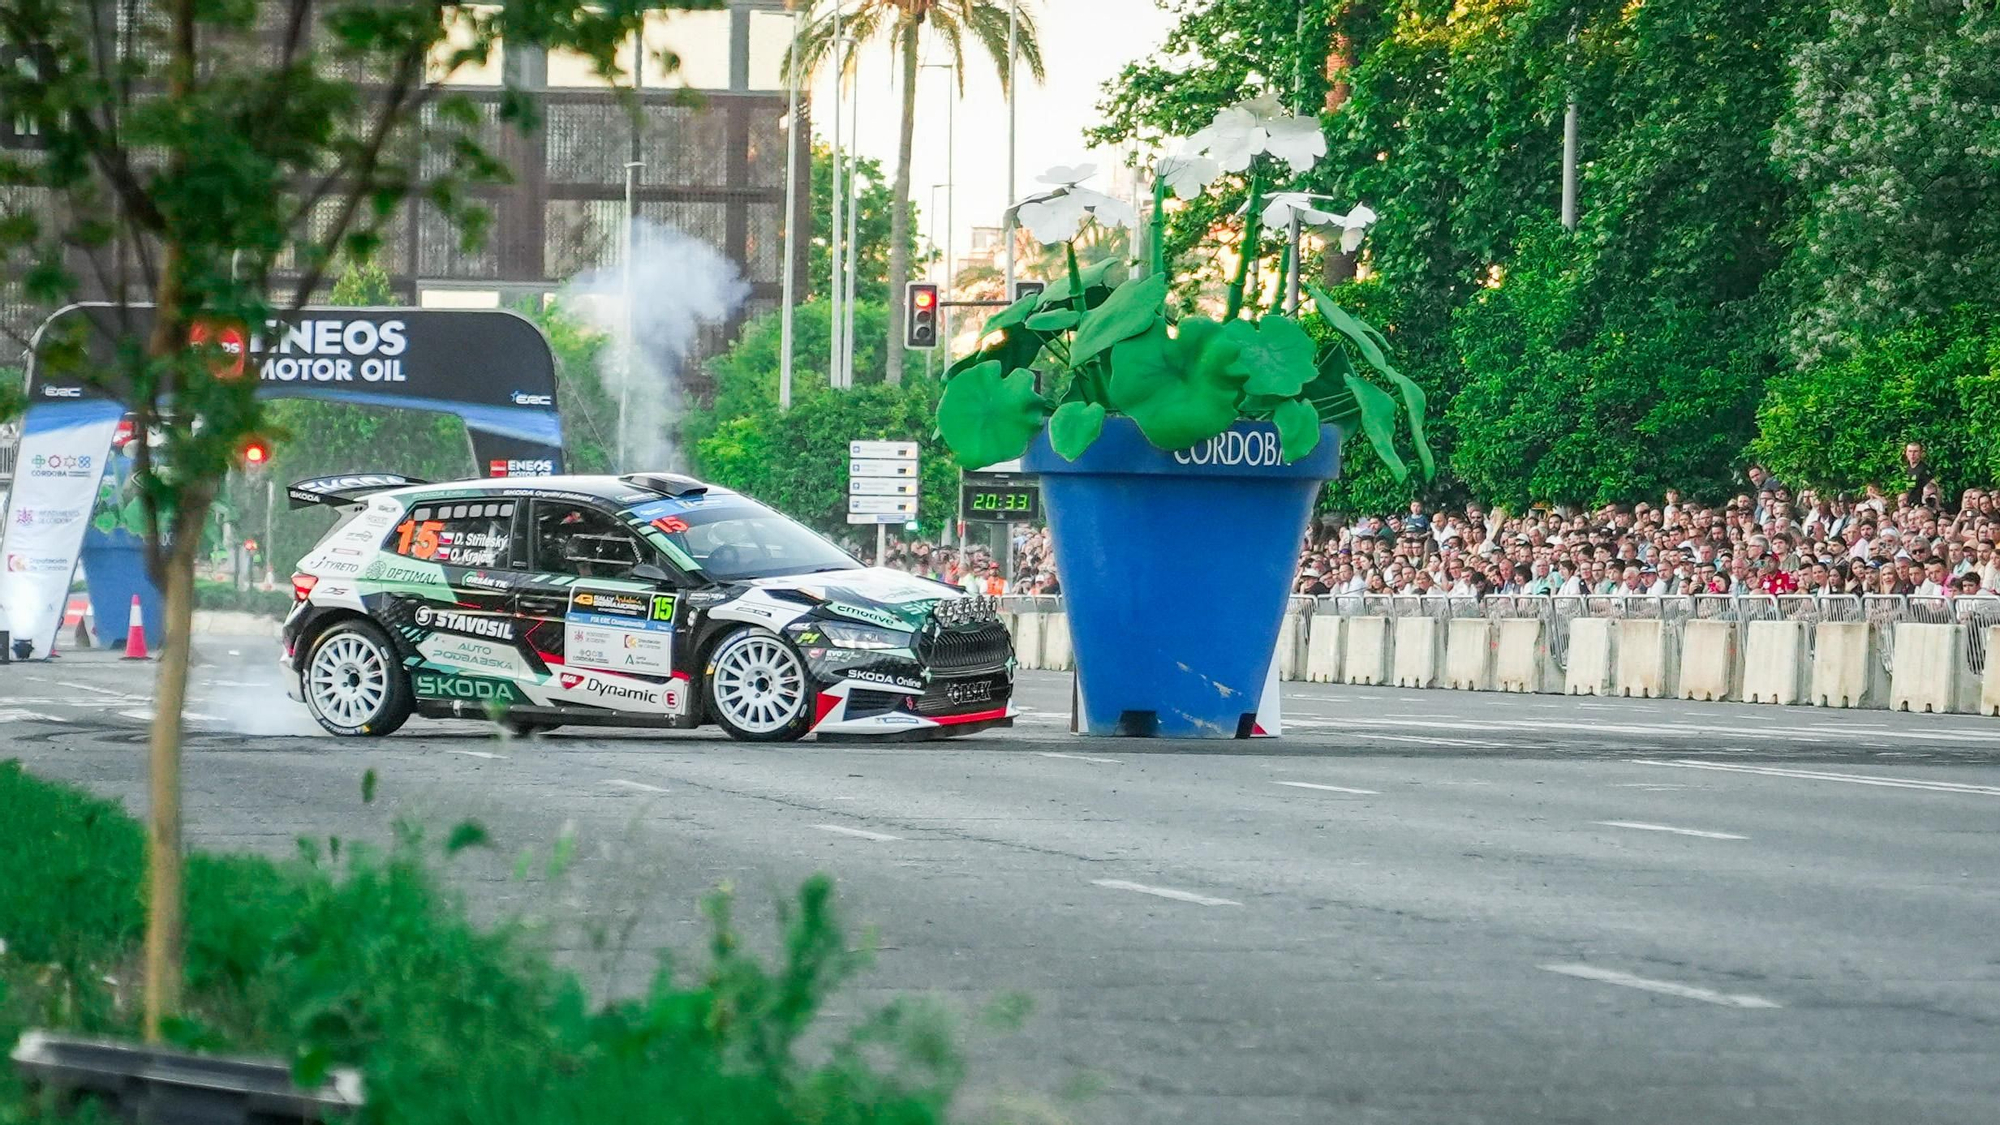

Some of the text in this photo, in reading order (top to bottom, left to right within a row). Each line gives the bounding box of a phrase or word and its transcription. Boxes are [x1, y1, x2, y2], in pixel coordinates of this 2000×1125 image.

[360, 358, 406, 382] OIL
[508, 460, 553, 472] ENEOS
[973, 493, 1028, 510] 20:33
[650, 516, 689, 535] 15
[397, 519, 445, 559] 15
[454, 532, 464, 546] D.
[450, 547, 461, 561] O.
[325, 560, 359, 573] TYRETO
[386, 566, 438, 586] OPTIMAL
[652, 596, 674, 621] 15
[434, 611, 514, 640] STAVOSIL
[458, 643, 492, 655] AUTO
[586, 678, 676, 705] Dynamic E
[896, 676, 922, 689] Online
